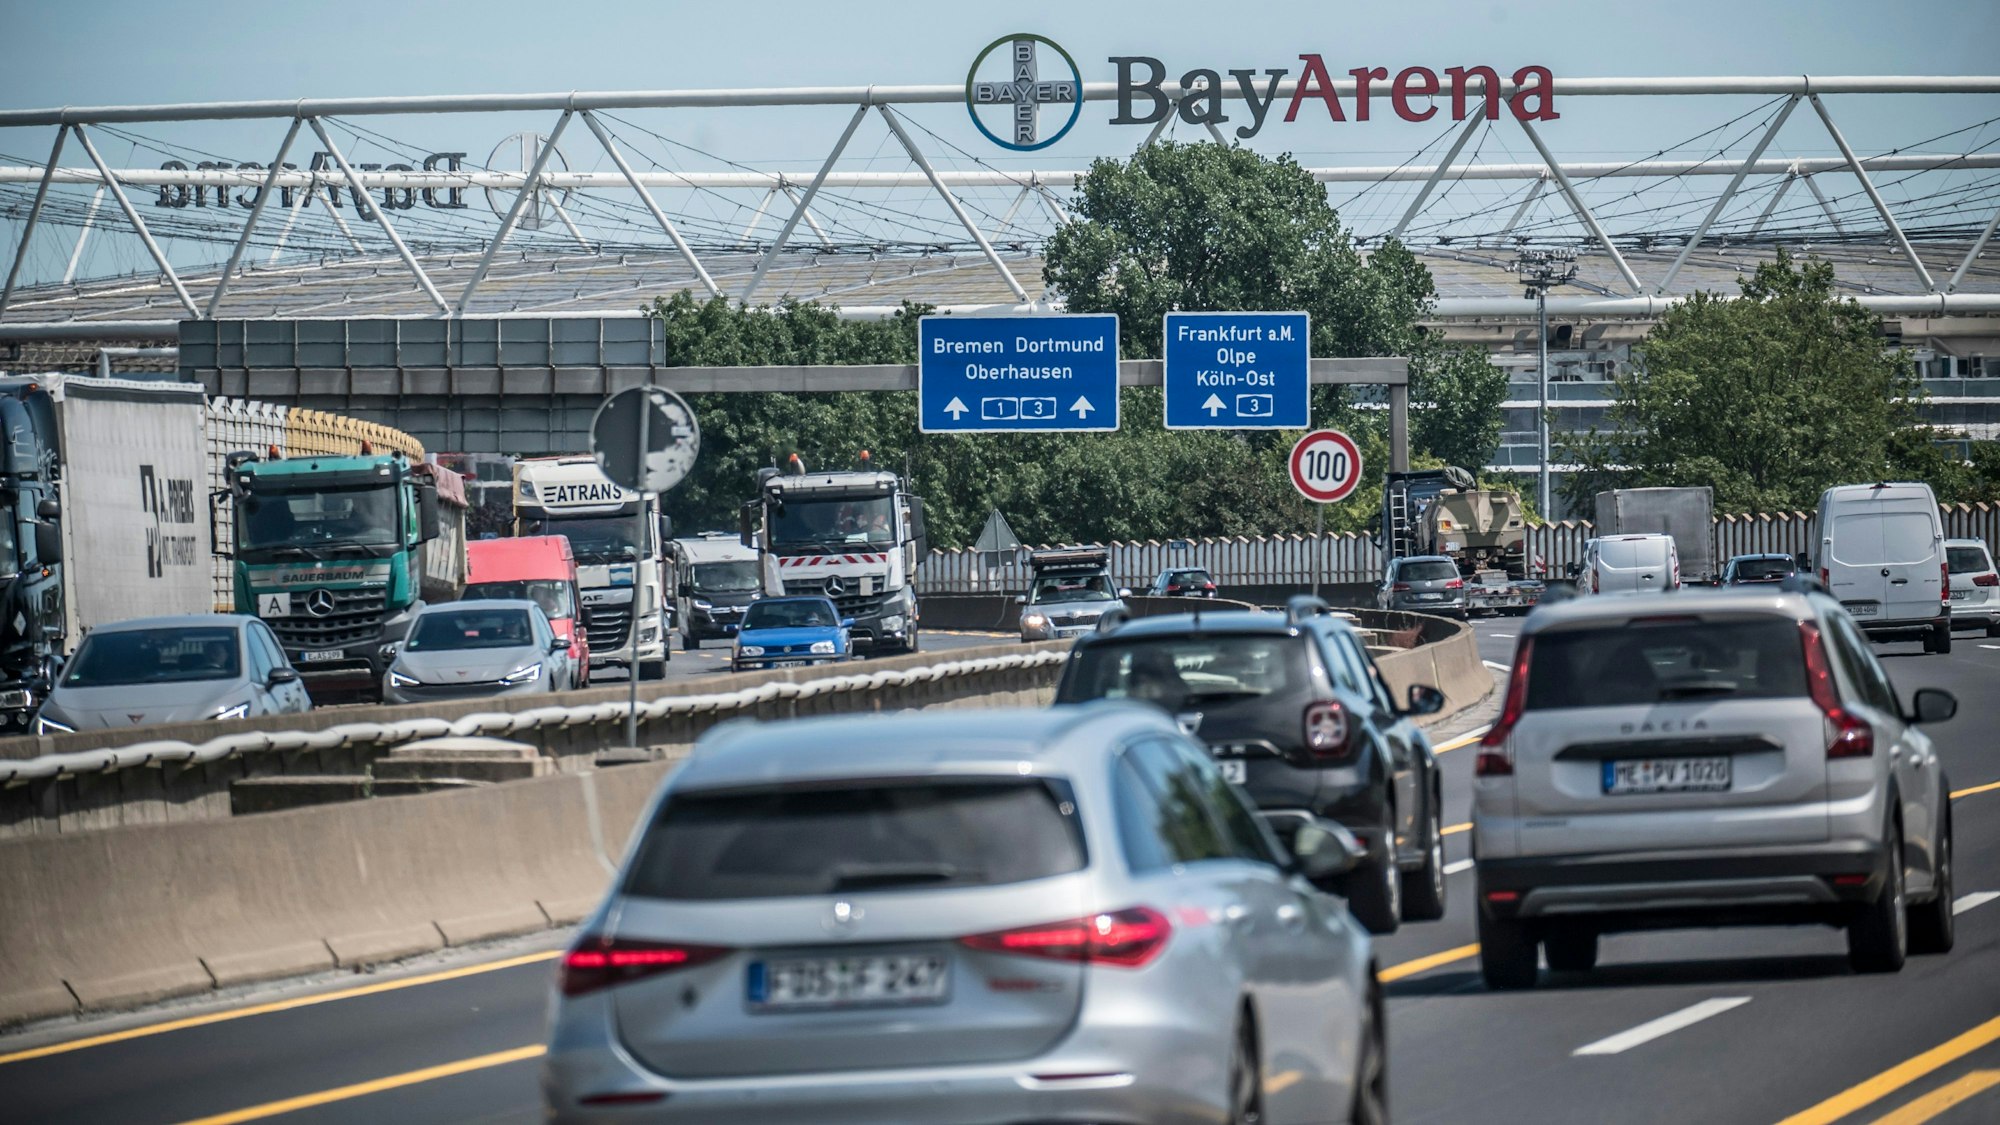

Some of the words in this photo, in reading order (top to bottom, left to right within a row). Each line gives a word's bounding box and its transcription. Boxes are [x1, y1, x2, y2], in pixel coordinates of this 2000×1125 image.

[977, 83, 1073, 102] BAYER
[1014, 44, 1035, 142] BAYER
[1108, 53, 1561, 139] BayArena
[1178, 325, 1262, 342] Frankfurt
[1268, 325, 1295, 342] a.M.
[933, 337, 1004, 354] Bremen
[1016, 335, 1104, 353] Dortmund
[1216, 347, 1256, 367] Olpe
[965, 363, 1073, 380] Oberhausen
[1197, 370, 1275, 386] Köln-Ost
[997, 401, 1004, 416] 1
[1034, 401, 1043, 416] 3
[1250, 398, 1259, 413] 3
[1306, 449, 1346, 482] 100
[282, 571, 365, 583] SAUERBAUM
[268, 596, 282, 614] A
[582, 594, 604, 602] AF
[1620, 719, 1708, 734] DACIA
